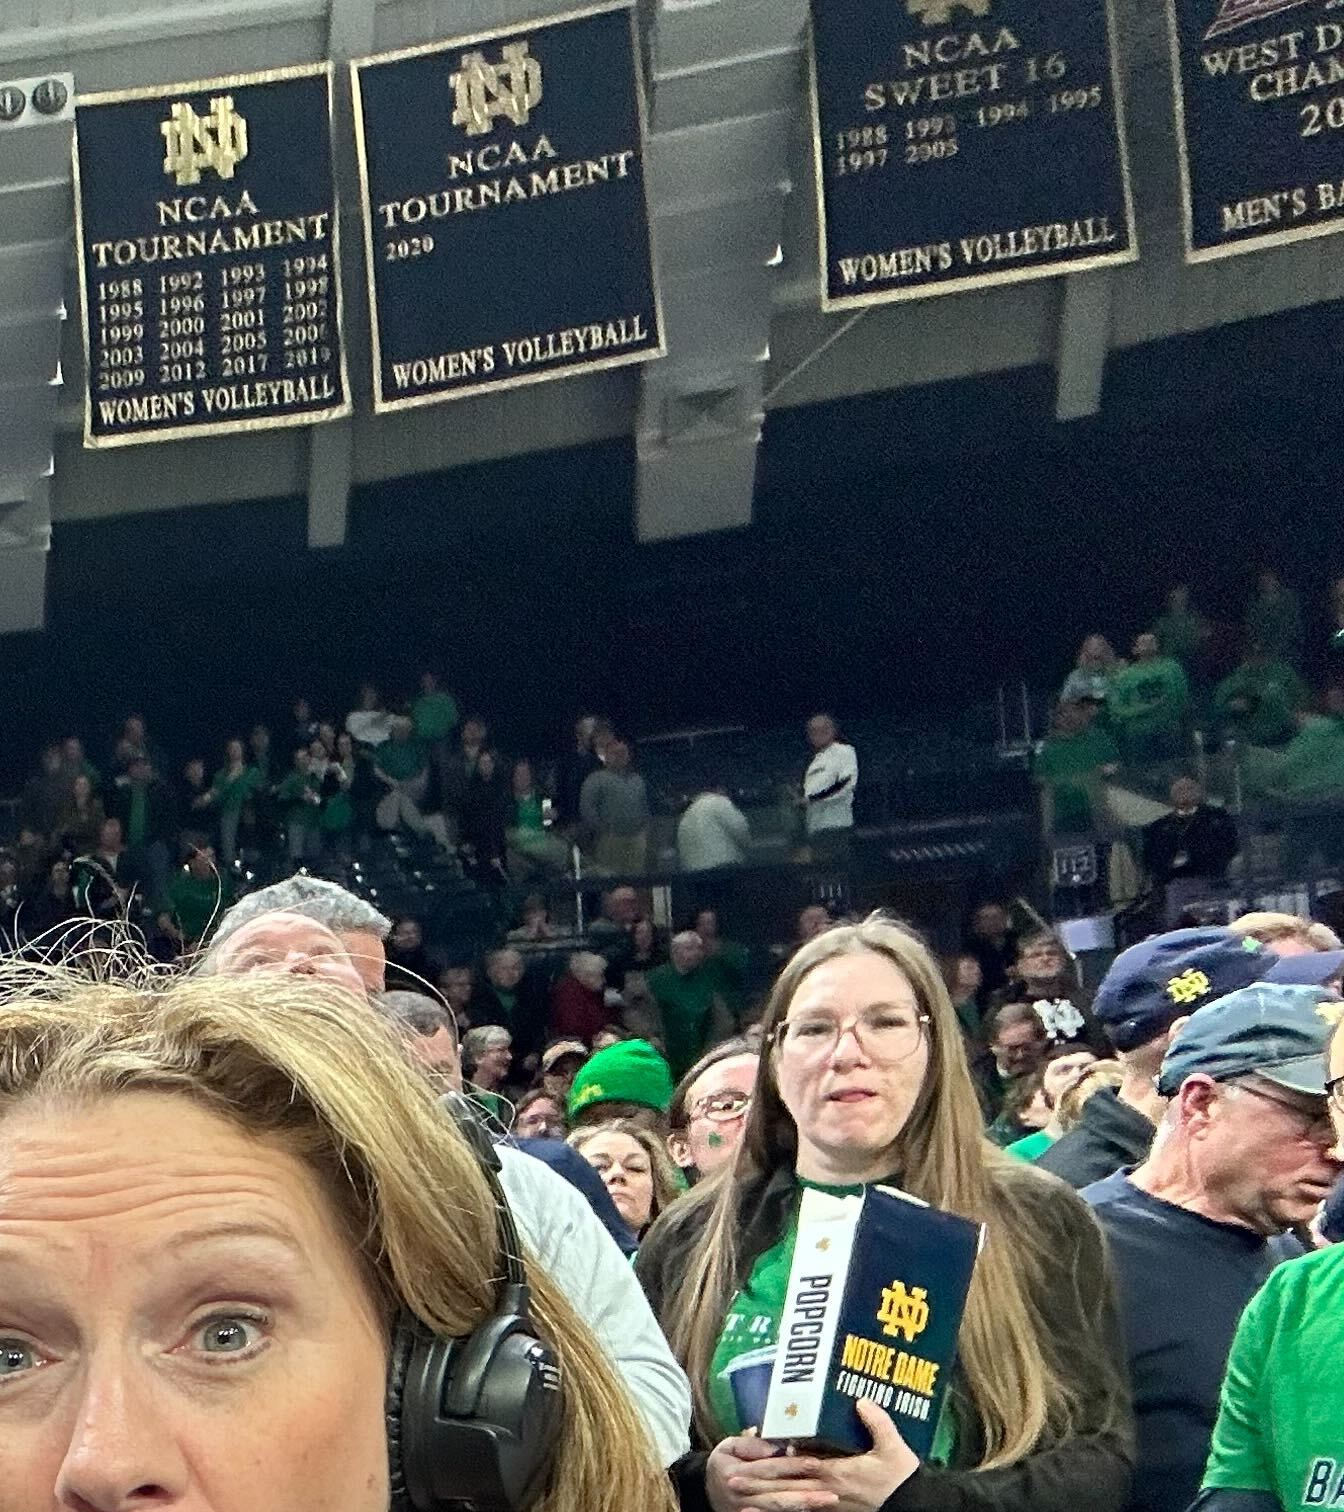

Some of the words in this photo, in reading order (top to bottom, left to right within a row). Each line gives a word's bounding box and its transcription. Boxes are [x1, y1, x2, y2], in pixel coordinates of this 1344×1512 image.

[902, 26, 1021, 70] NCAA
[1200, 31, 1304, 76] WEST
[864, 62, 1005, 111] SWEET
[1026, 52, 1066, 83] 16
[448, 134, 559, 180] NCAA
[156, 190, 260, 226] NCAA
[378, 150, 634, 228] TOURNAMENT
[1223, 187, 1307, 232] MEN'S
[91, 212, 328, 269] TOURNAMENT
[838, 242, 953, 286] WOMEN'S
[960, 216, 1115, 265] VOLLEYBALL
[160, 293, 205, 316] 1996
[222, 285, 266, 309] 1997
[221, 308, 264, 332] 2001
[393, 345, 495, 390] WOMEN'S
[502, 314, 648, 367] VOLLEYBALL
[99, 390, 195, 426] WOMEN'S
[202, 374, 335, 414] VOLLEYBALL
[781, 1273, 832, 1385] POPCORN
[841, 1334, 893, 1380] NOTRE
[893, 1351, 940, 1397] DAME
[837, 1371, 894, 1409] FIGHTING
[895, 1392, 930, 1421] IRISH
